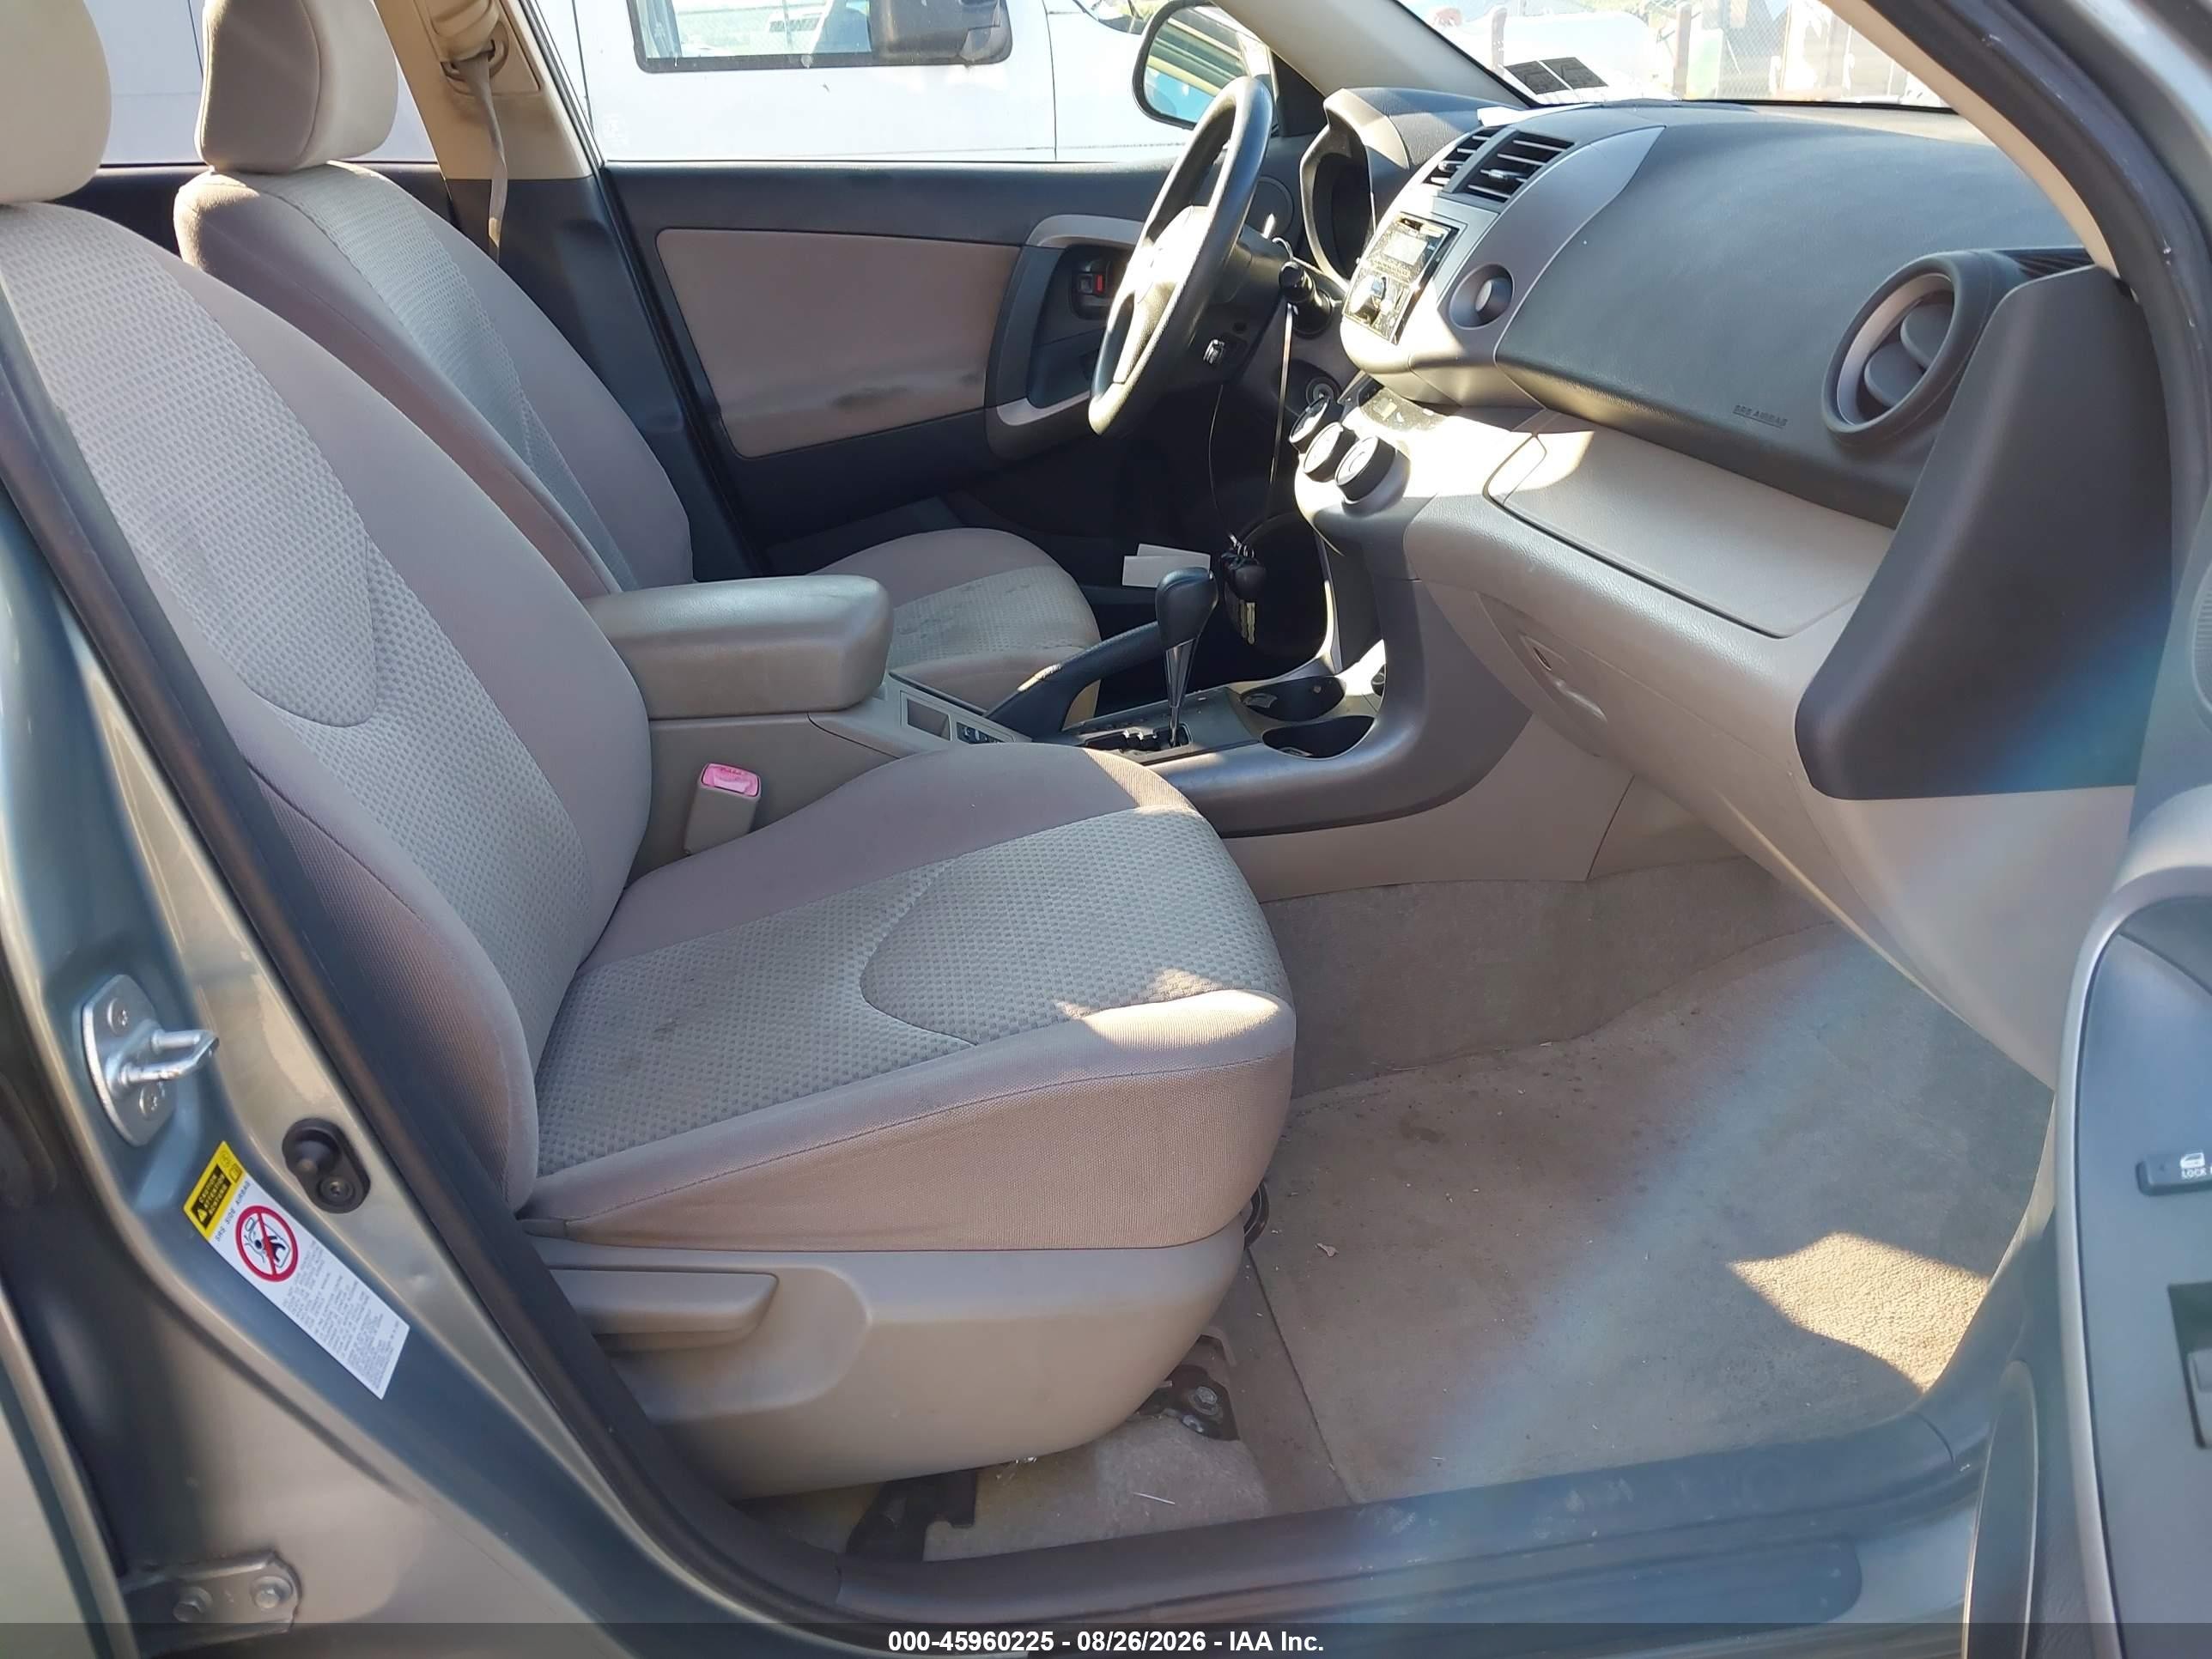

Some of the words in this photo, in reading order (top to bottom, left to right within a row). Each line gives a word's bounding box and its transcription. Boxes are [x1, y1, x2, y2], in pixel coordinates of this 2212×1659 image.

[2181, 1166, 2207, 1179] LOCK
[198, 1173, 217, 1204] CAUTION
[203, 1173, 226, 1210] ATTENTION
[234, 1179, 252, 1206] AIRBAG
